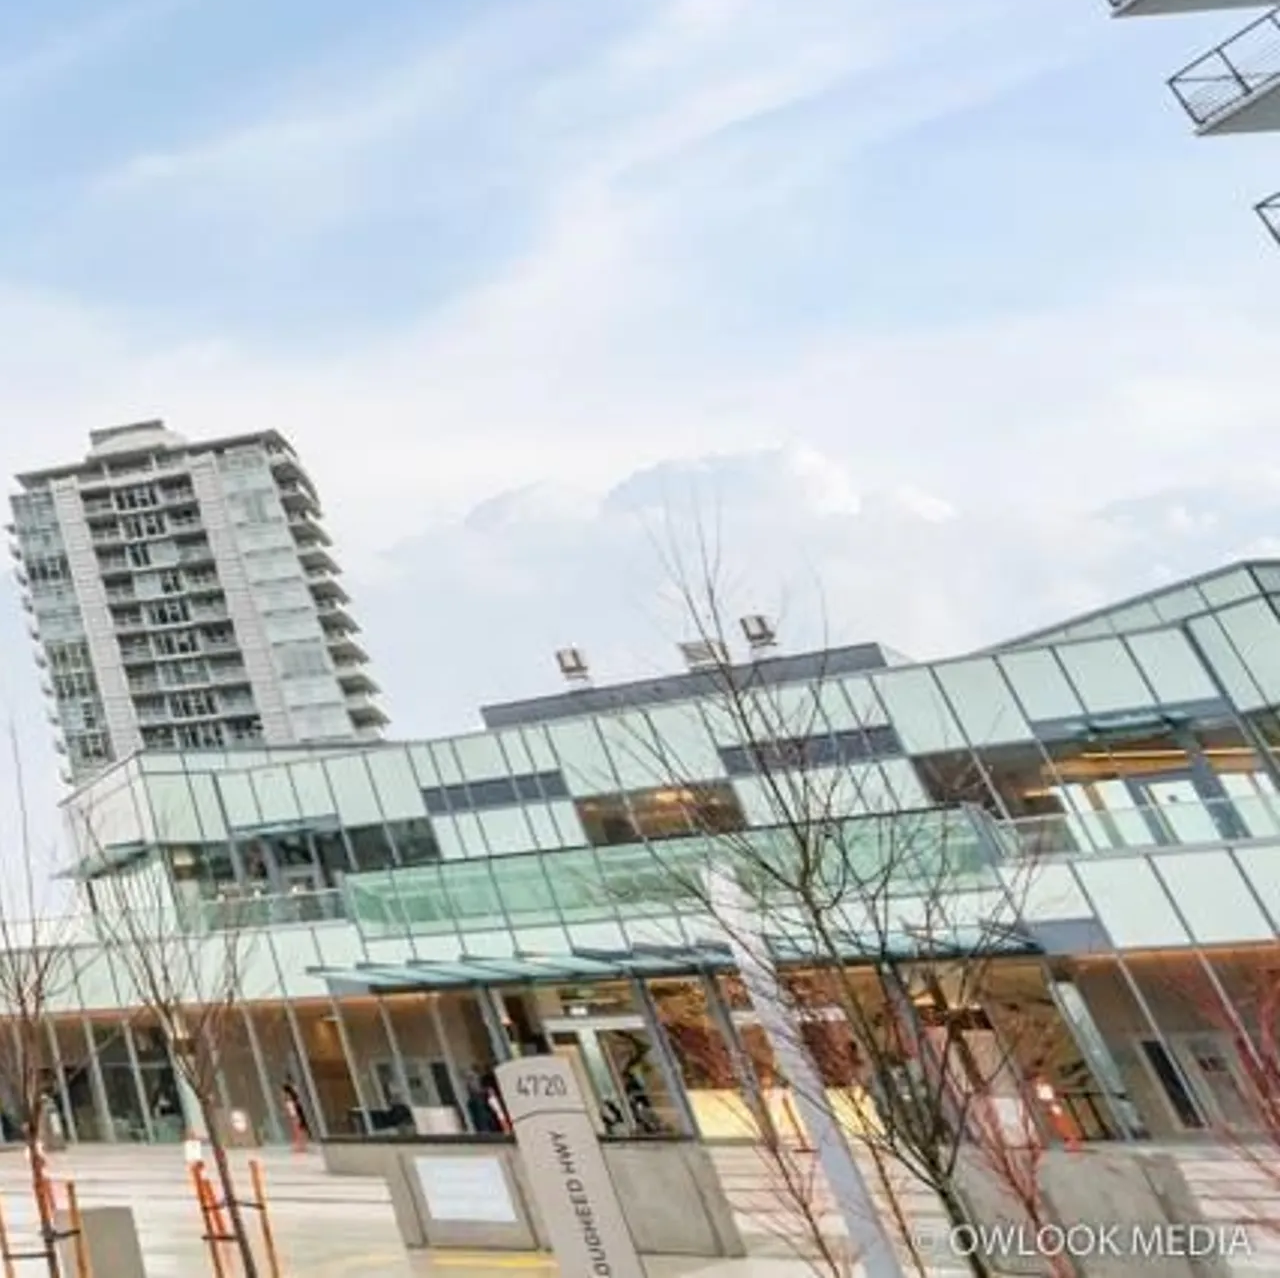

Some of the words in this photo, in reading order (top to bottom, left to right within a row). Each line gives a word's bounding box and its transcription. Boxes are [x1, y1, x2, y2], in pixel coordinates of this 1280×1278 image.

[517, 1074, 567, 1097] 4720
[548, 1130, 577, 1174] HWY
[566, 1178, 613, 1278] OUGHEED
